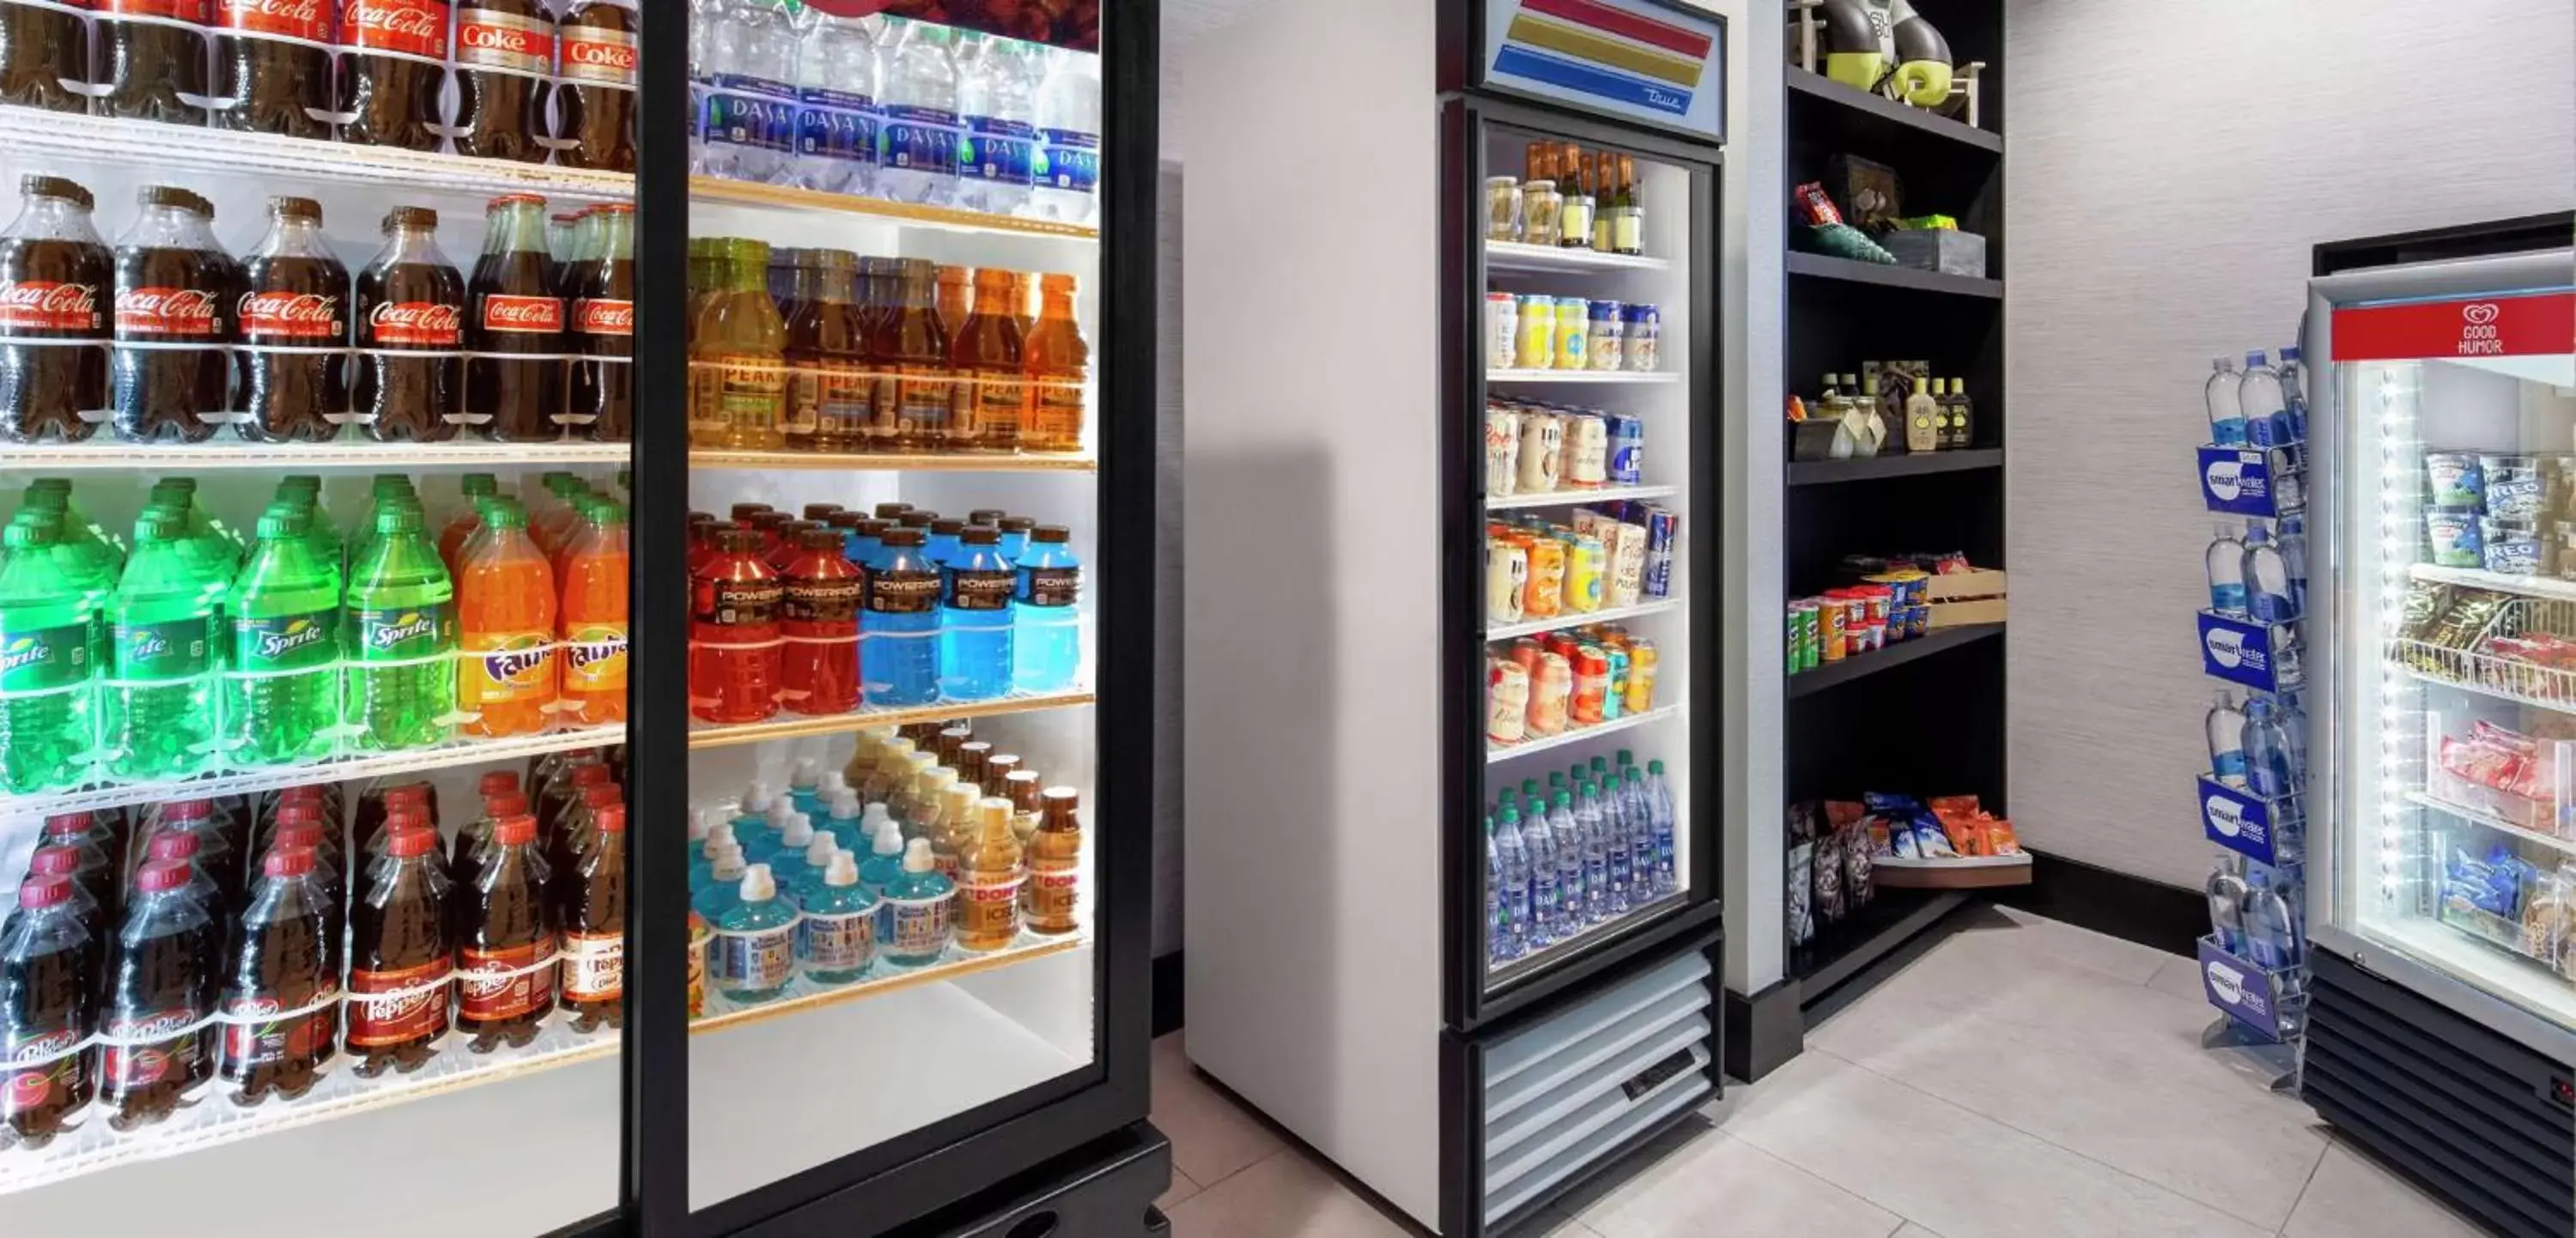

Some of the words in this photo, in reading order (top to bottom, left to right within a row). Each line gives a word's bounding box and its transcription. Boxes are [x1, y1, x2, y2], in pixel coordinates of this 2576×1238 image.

[344, 5, 439, 39] Coca-Cola
[463, 25, 526, 52] Coke
[571, 42, 632, 68] Coke
[1643, 88, 1681, 108] True
[115, 287, 217, 319] Coca-Cola
[236, 291, 338, 321] Coca-Cola
[370, 300, 462, 331] Coca-Cola
[489, 302, 556, 323] Coca-Cola
[2463, 325, 2497, 340] GOOD
[2458, 339, 2504, 355] HUMOR
[261, 627, 321, 655] Sprite
[374, 617, 431, 646] Sprite
[0, 645, 50, 675] prite
